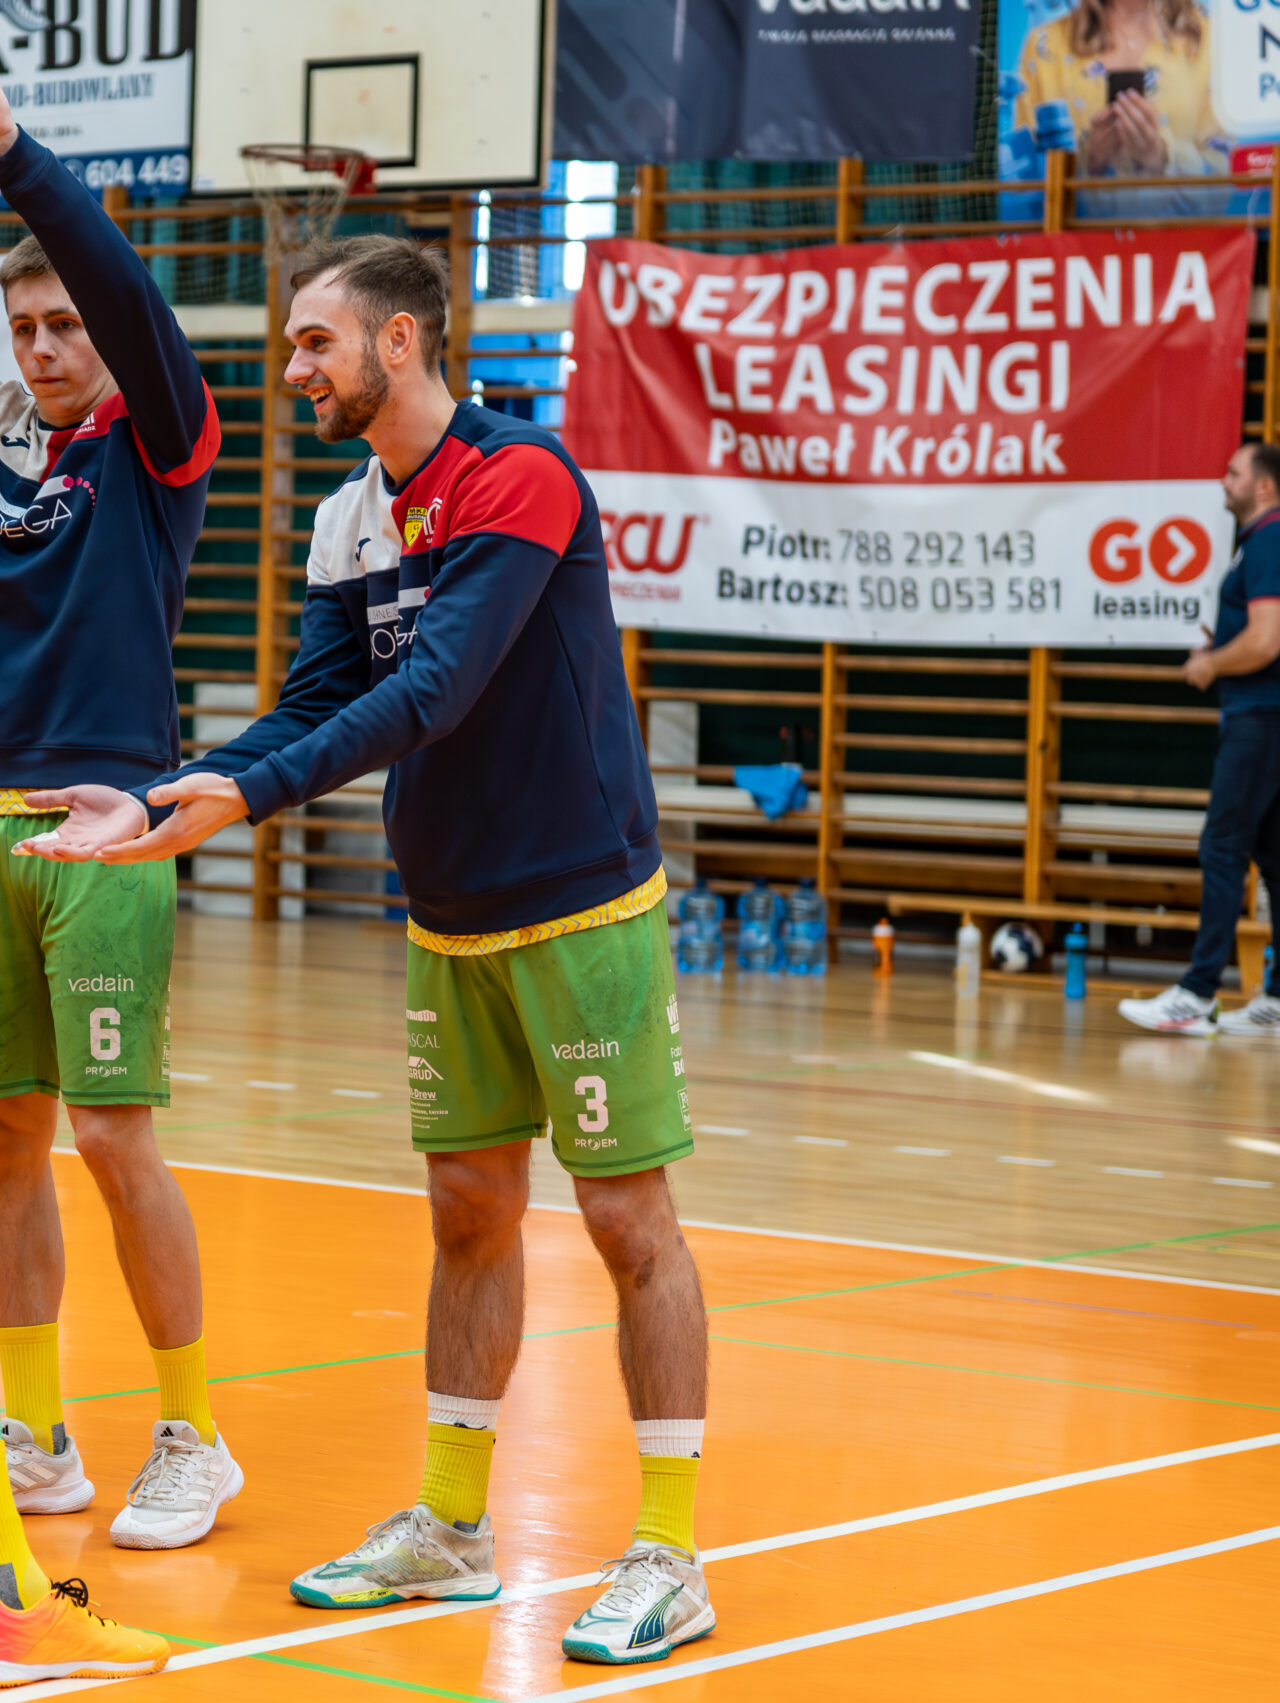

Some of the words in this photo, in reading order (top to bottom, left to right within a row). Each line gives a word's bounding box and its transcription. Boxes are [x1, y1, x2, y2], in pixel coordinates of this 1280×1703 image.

[85, 161, 133, 189] 604
[137, 154, 189, 185] 449
[597, 250, 1216, 337] UBEZPIECZENIA
[695, 340, 1071, 416] LEASINGI
[707, 417, 857, 477] Paweł
[870, 416, 1067, 476] Królak
[742, 524, 831, 564] Piotr:
[836, 529, 892, 565] 788
[903, 530, 965, 567] 292
[975, 530, 1036, 567] 143
[717, 568, 848, 608] Bartosz:
[858, 575, 920, 612] 508
[931, 576, 995, 612] 053
[1006, 576, 1062, 613] 581
[1093, 590, 1202, 621] leasing
[68, 973, 135, 992] vadain
[89, 1006, 121, 1061] 6
[551, 1038, 621, 1060] vadain
[574, 1075, 610, 1133] 3
